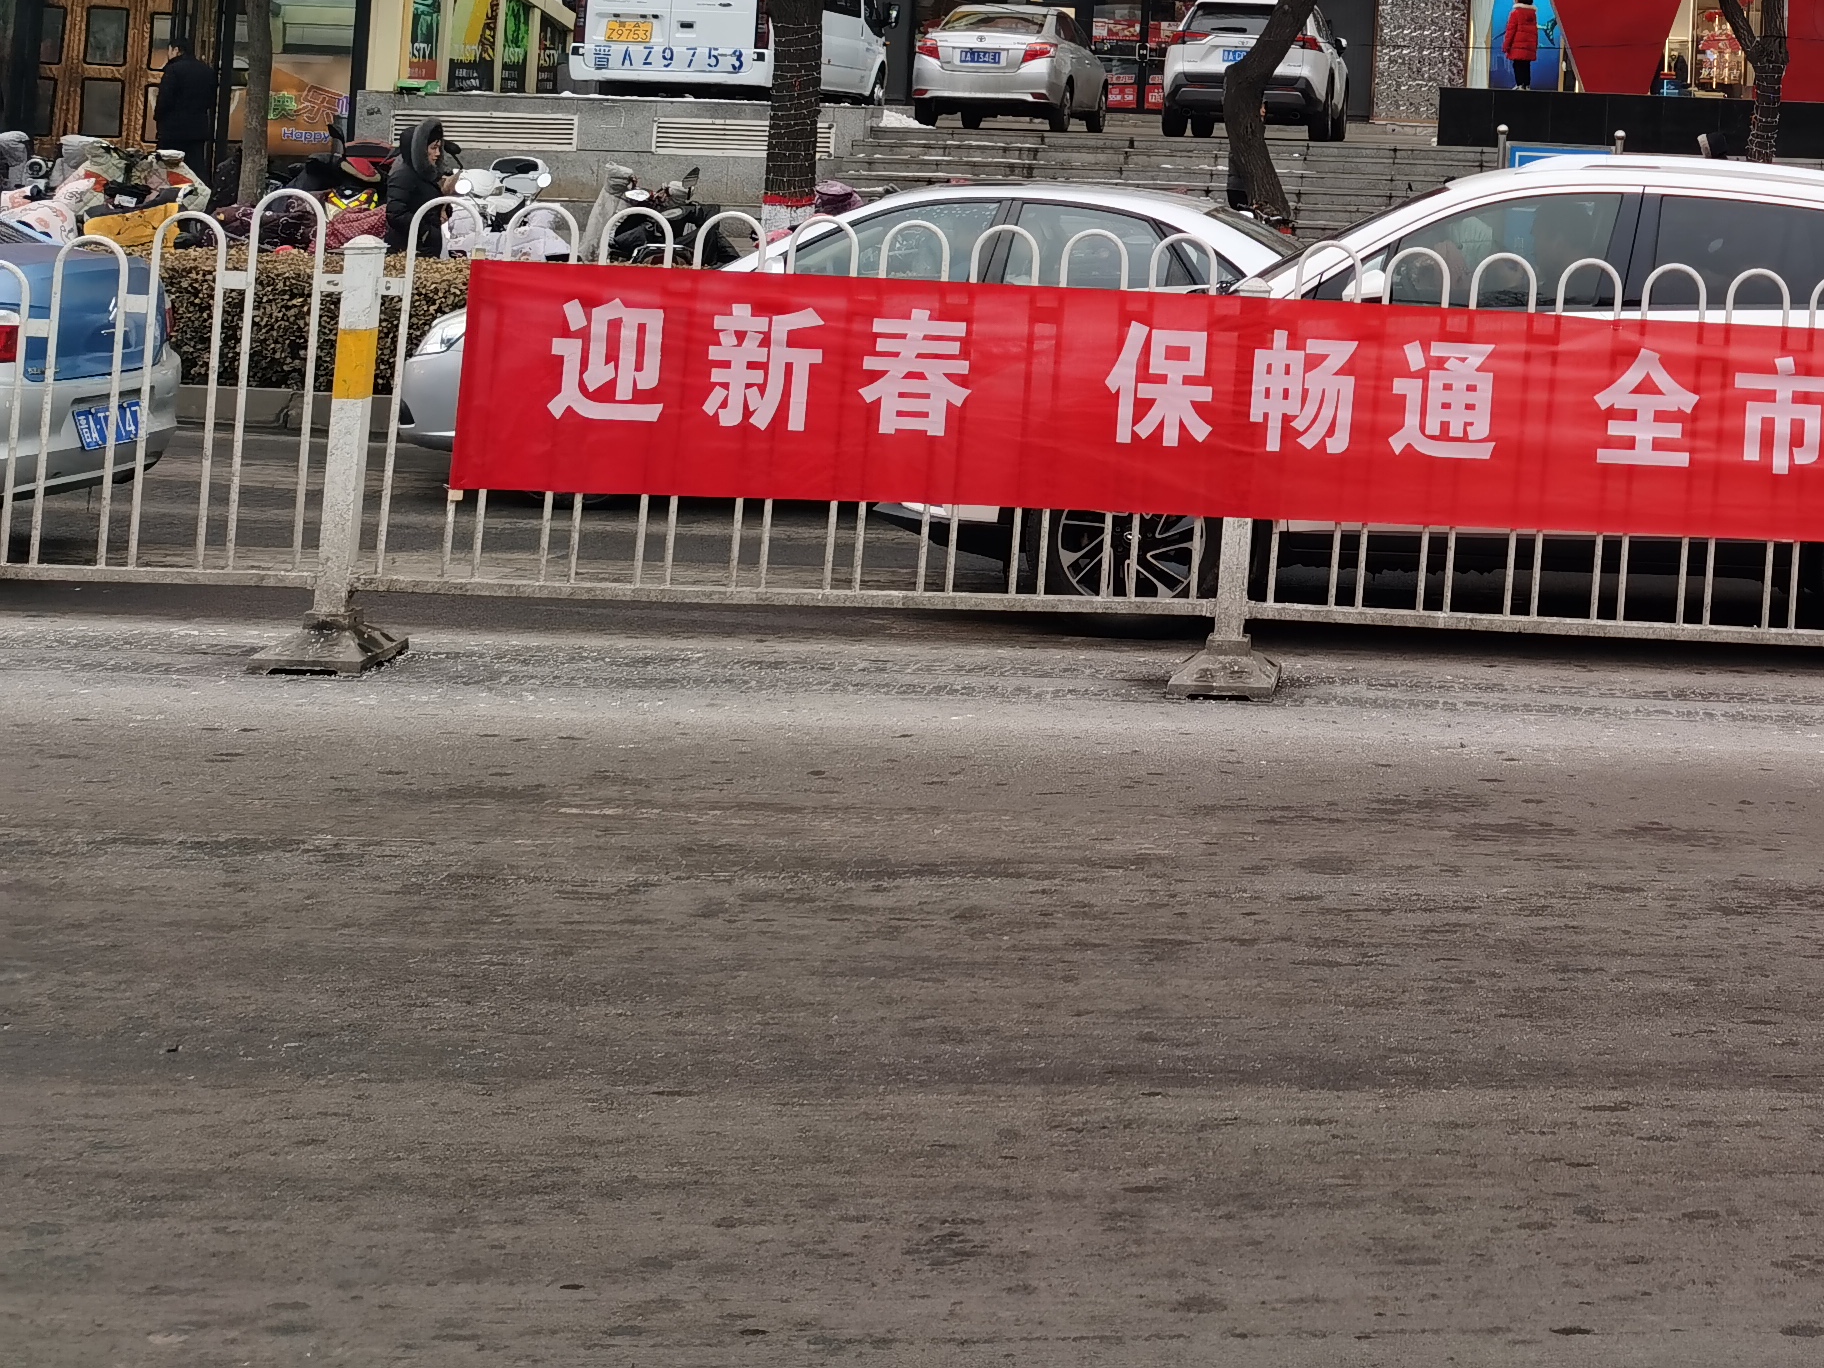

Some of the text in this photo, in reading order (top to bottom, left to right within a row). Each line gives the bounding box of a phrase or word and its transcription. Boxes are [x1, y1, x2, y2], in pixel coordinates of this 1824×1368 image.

[607, 28, 649, 41] Z9753
[281, 126, 330, 144] Happy
[547, 298, 971, 436] 迎新春
[1105, 320, 1496, 460] 保畅通
